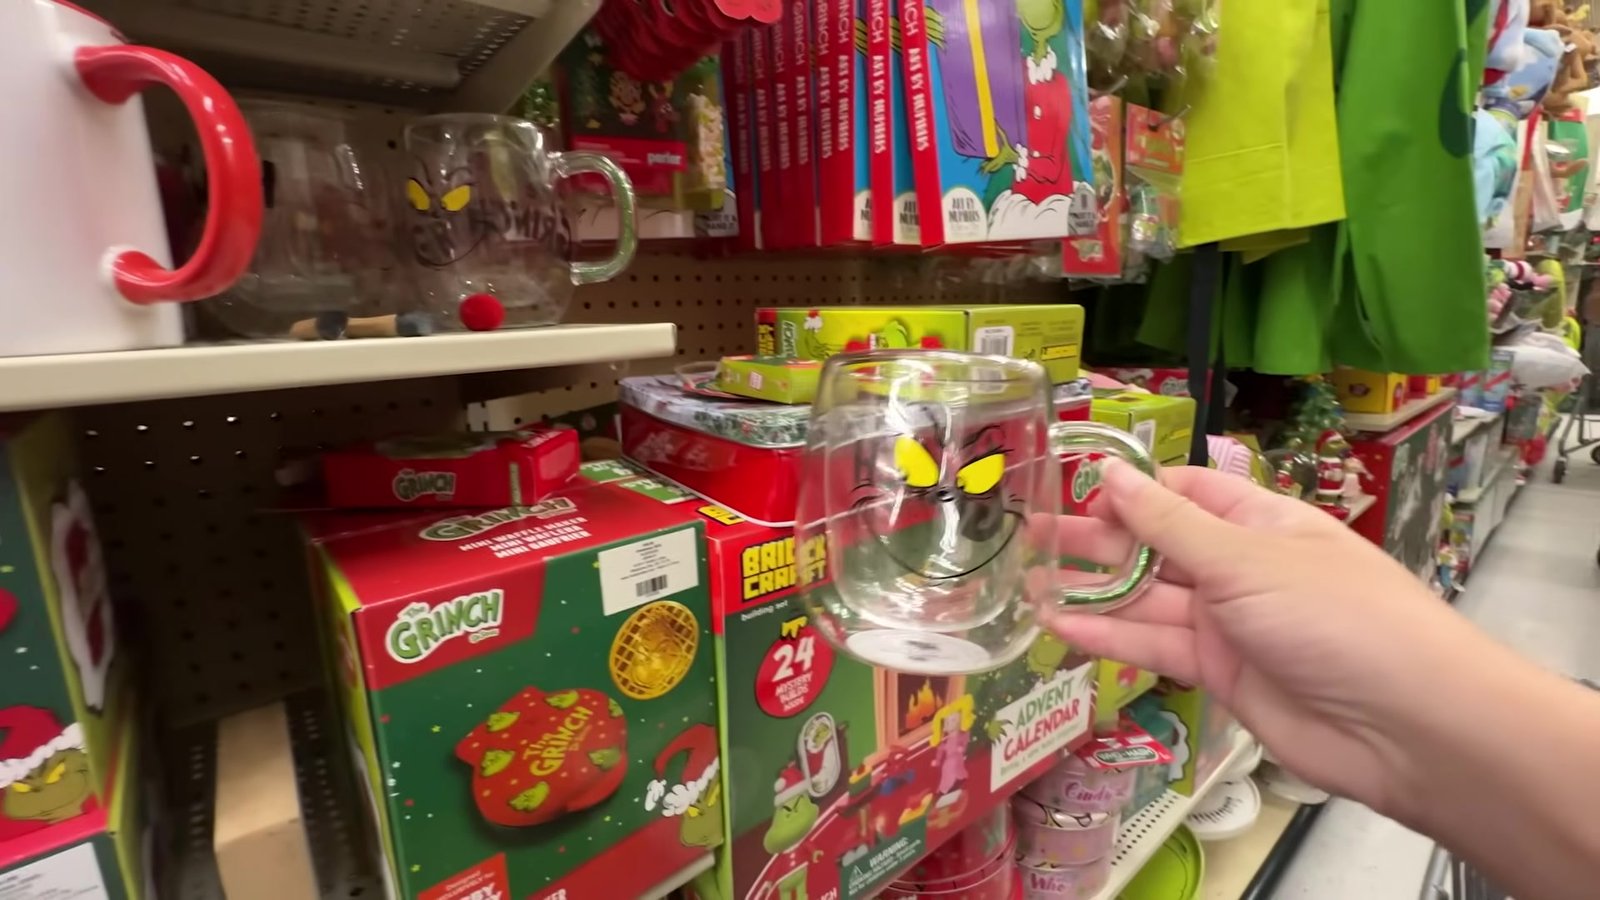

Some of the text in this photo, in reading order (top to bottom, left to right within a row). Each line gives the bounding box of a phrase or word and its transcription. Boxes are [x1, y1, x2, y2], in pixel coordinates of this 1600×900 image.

[838, 55, 849, 76] ART
[872, 55, 885, 77] ART
[908, 48, 922, 71] ART
[838, 79, 849, 93] BY
[873, 79, 885, 95] BY
[911, 73, 924, 89] BY
[838, 98, 849, 151] NUMBERS
[874, 99, 886, 154] NUMBERS
[913, 93, 929, 151] NUMBERS
[423, 499, 572, 540] GRINCH
[459, 517, 588, 551] MINI WAFFLE MAKER
[489, 539, 524, 552] MINI
[494, 546, 531, 558] MINI
[740, 600, 789, 622] building set
[389, 591, 502, 661] GRINCH
[772, 636, 815, 682] 24
[1016, 677, 1074, 730] ADVENT
[529, 706, 594, 777] GRINCH
[1003, 698, 1080, 761] CALENDAR
[522, 740, 547, 761] The
